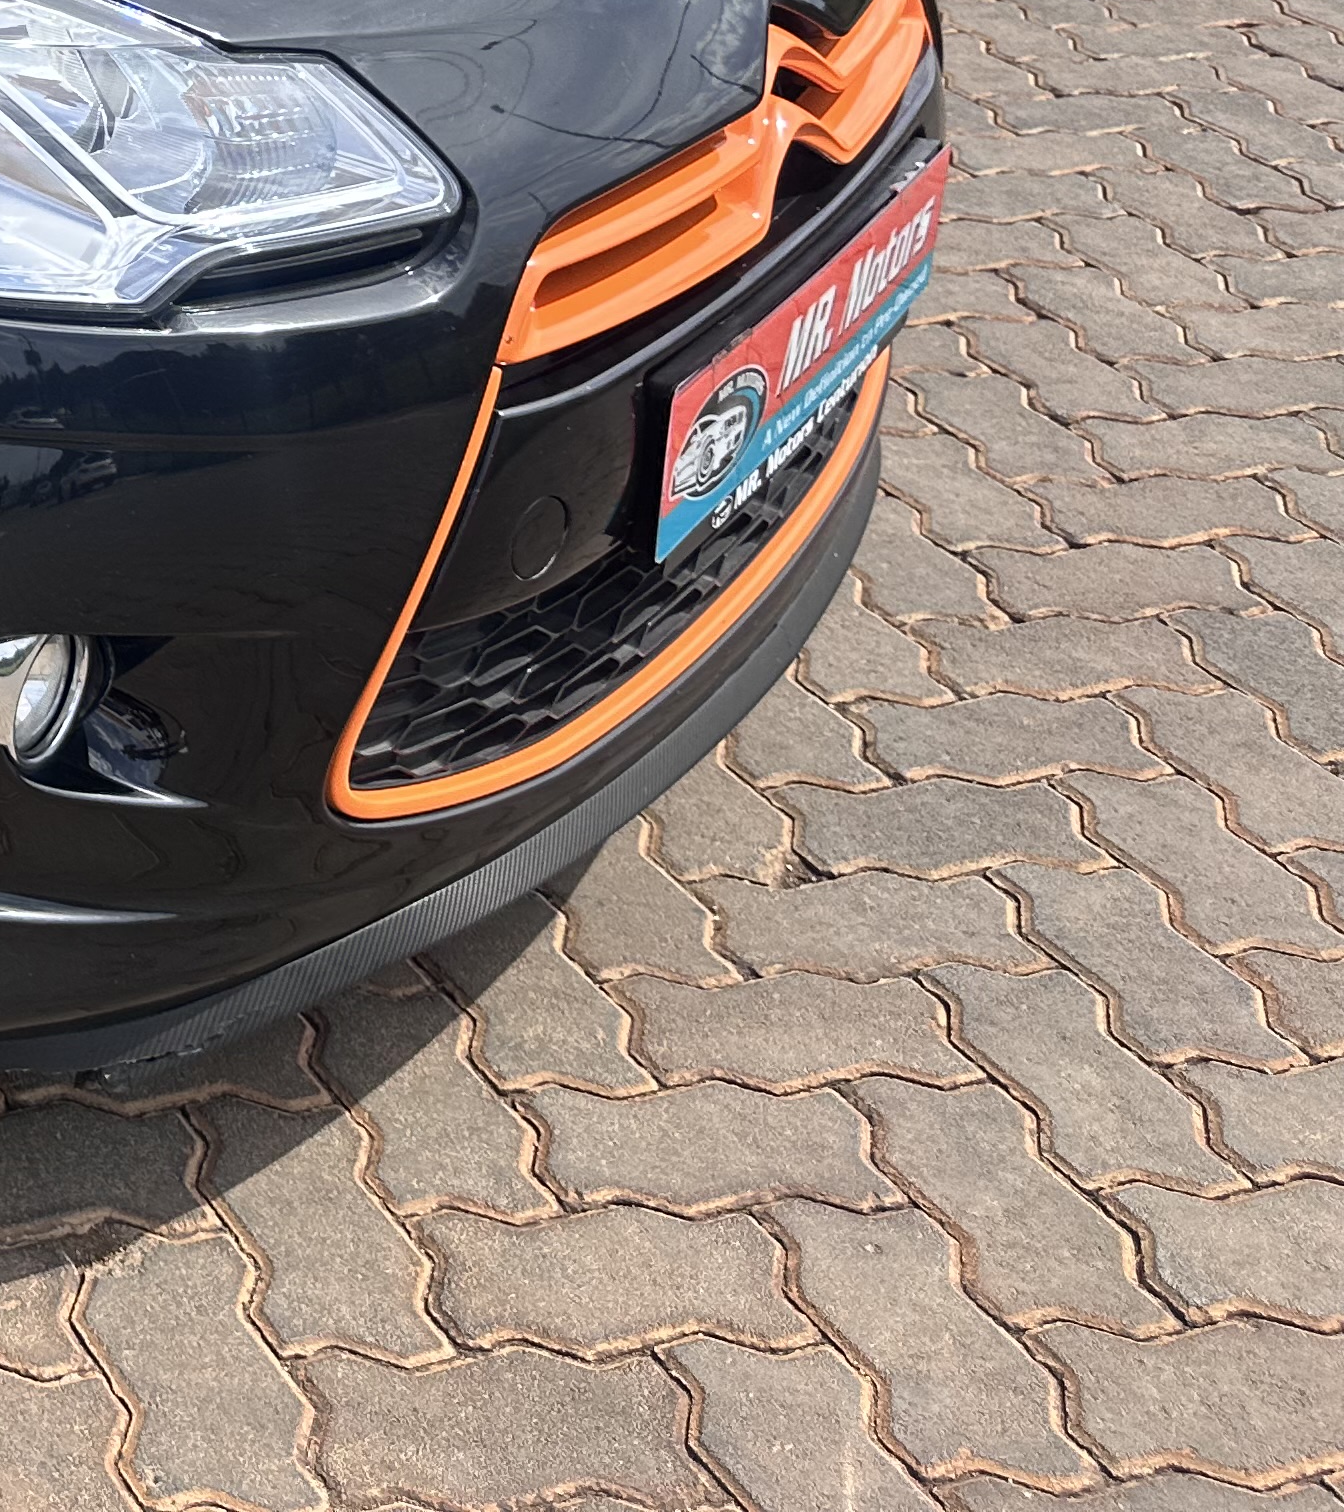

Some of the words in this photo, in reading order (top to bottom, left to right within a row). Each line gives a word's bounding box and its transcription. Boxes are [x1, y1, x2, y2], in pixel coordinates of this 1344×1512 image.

[775, 284, 838, 399] MR.
[837, 194, 936, 337] Motors
[734, 469, 762, 510] MR.
[765, 416, 814, 478] Motors
